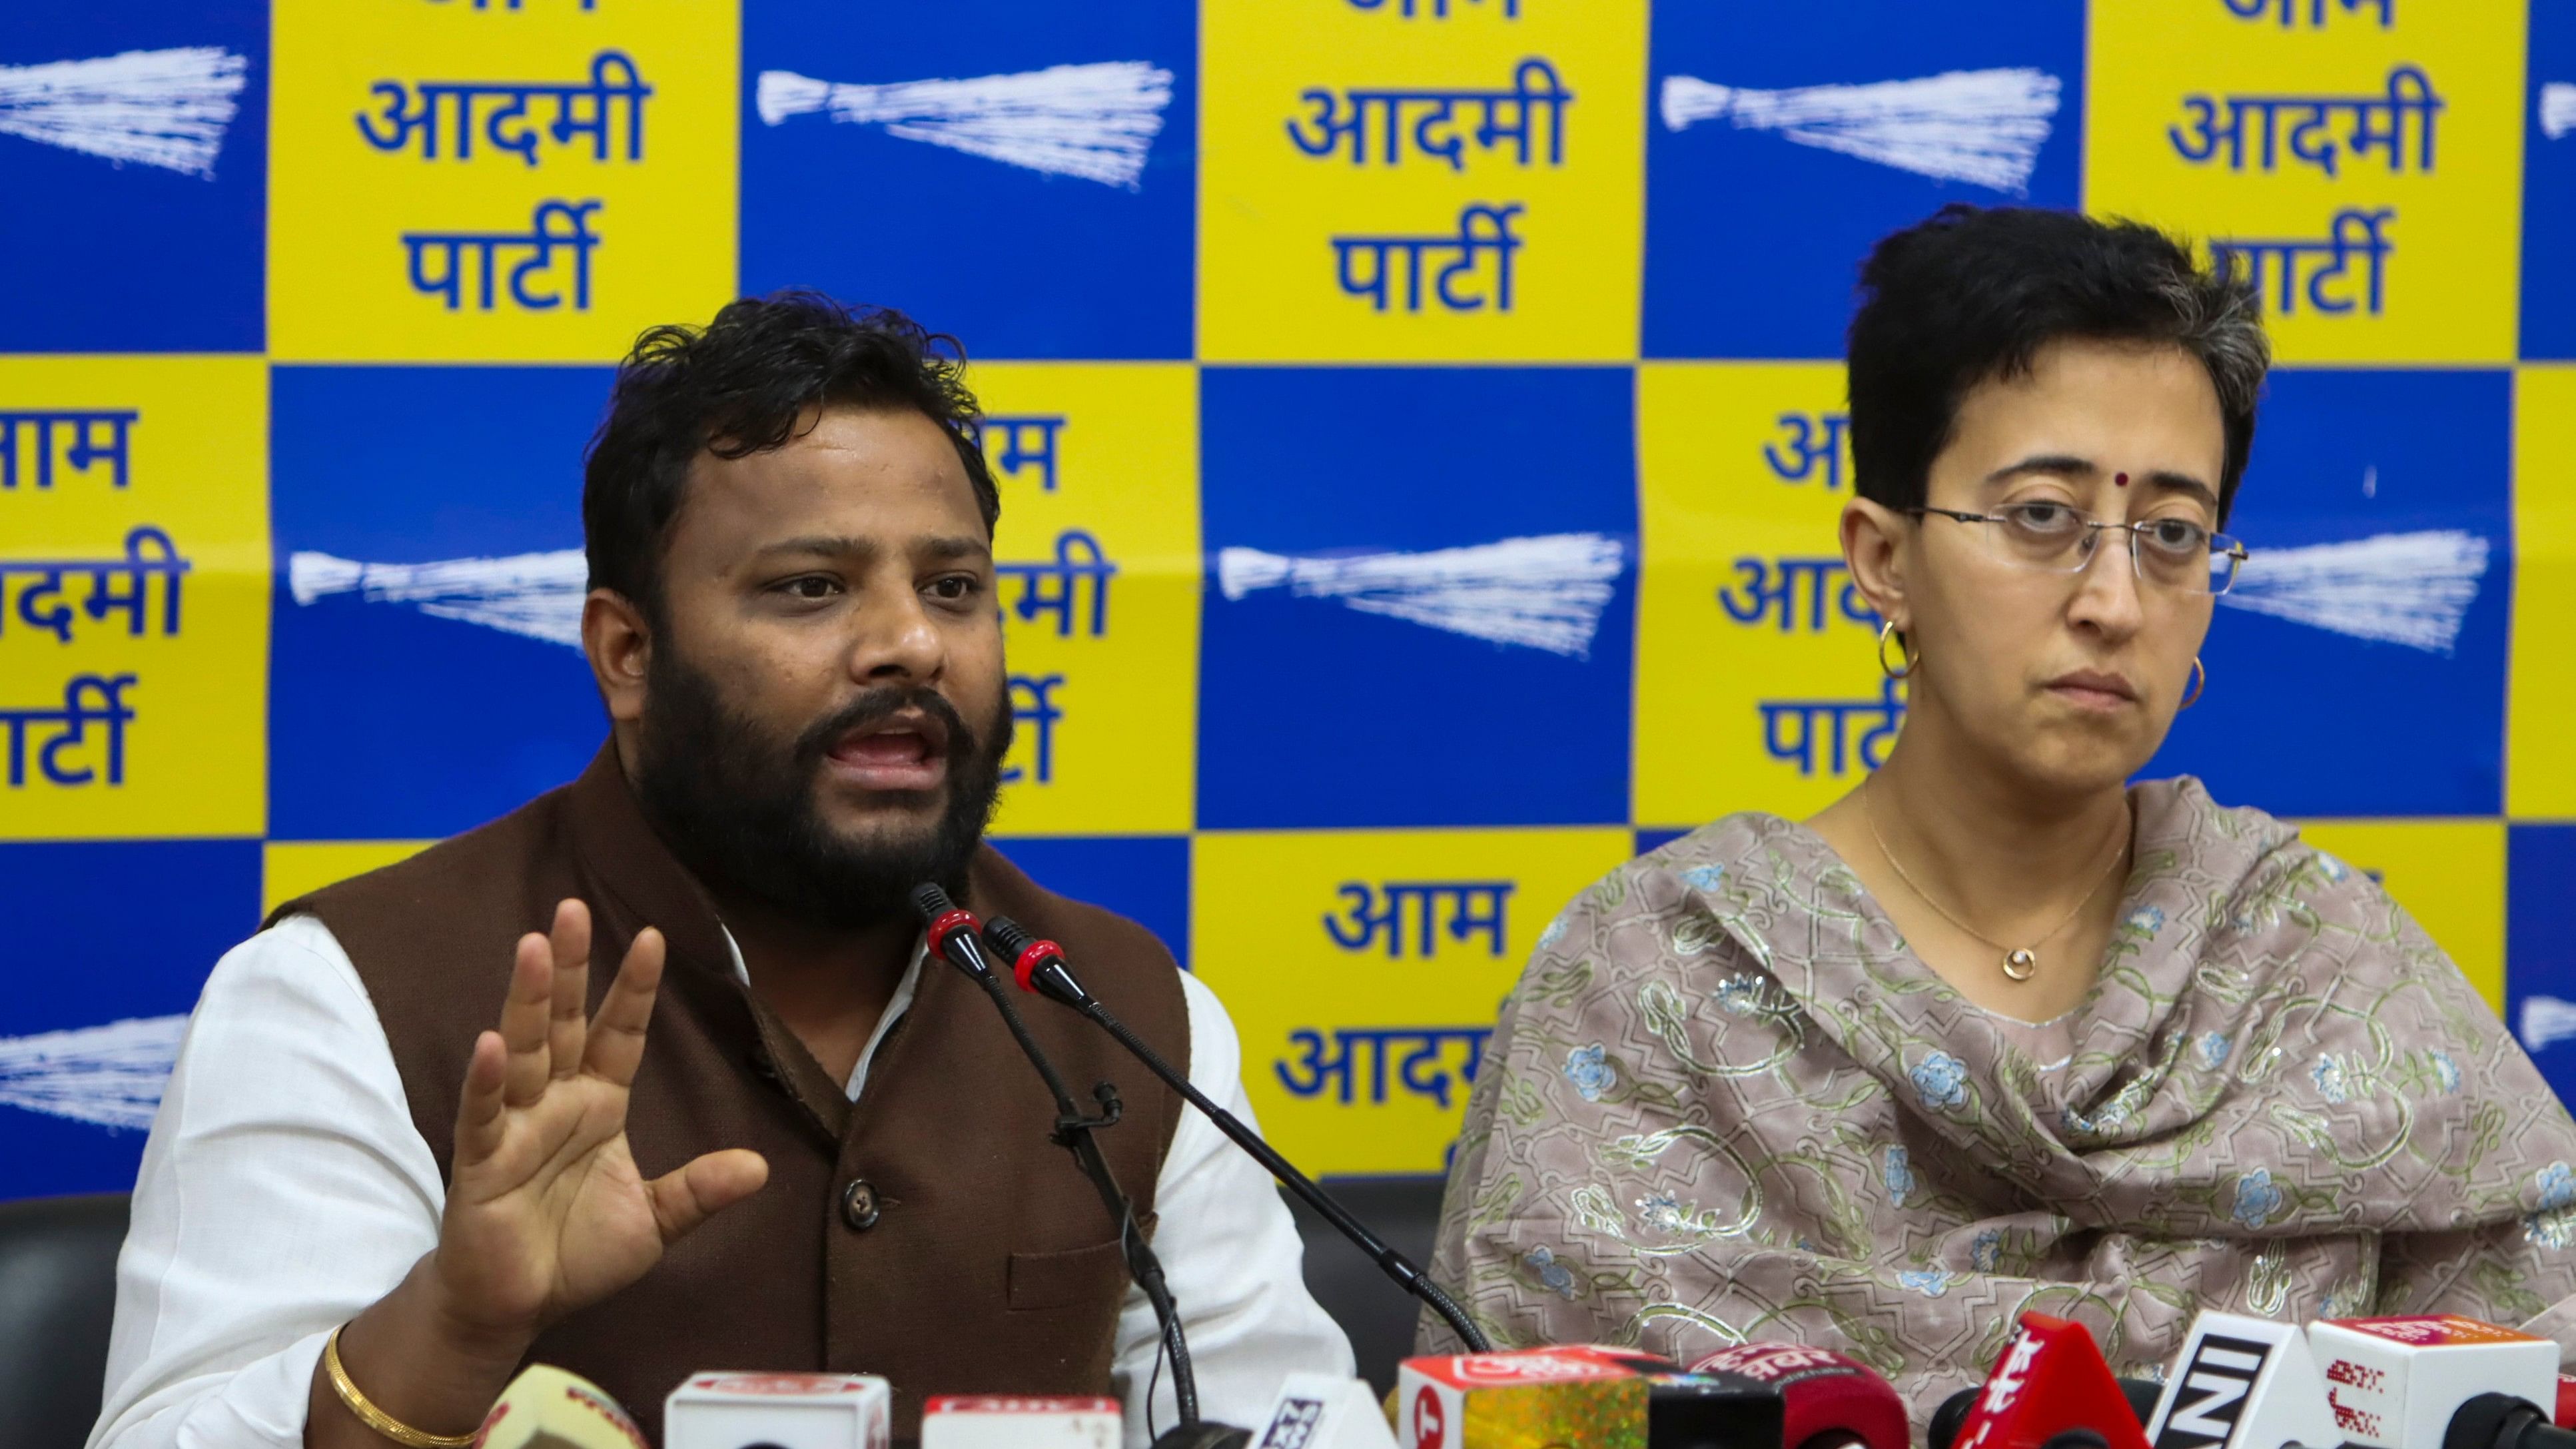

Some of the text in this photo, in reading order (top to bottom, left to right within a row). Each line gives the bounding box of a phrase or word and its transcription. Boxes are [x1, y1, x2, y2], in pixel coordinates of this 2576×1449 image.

[356, 50, 653, 167] आदमी
[1287, 58, 1573, 171] आदमी
[2169, 67, 2443, 175] आदमी
[402, 200, 602, 310] पार्टी
[1332, 205, 1523, 311] पार्टी
[0, 526, 191, 642] दमी
[1324, 882, 1514, 957] आम
[2168, 1346, 2264, 1449] NI
